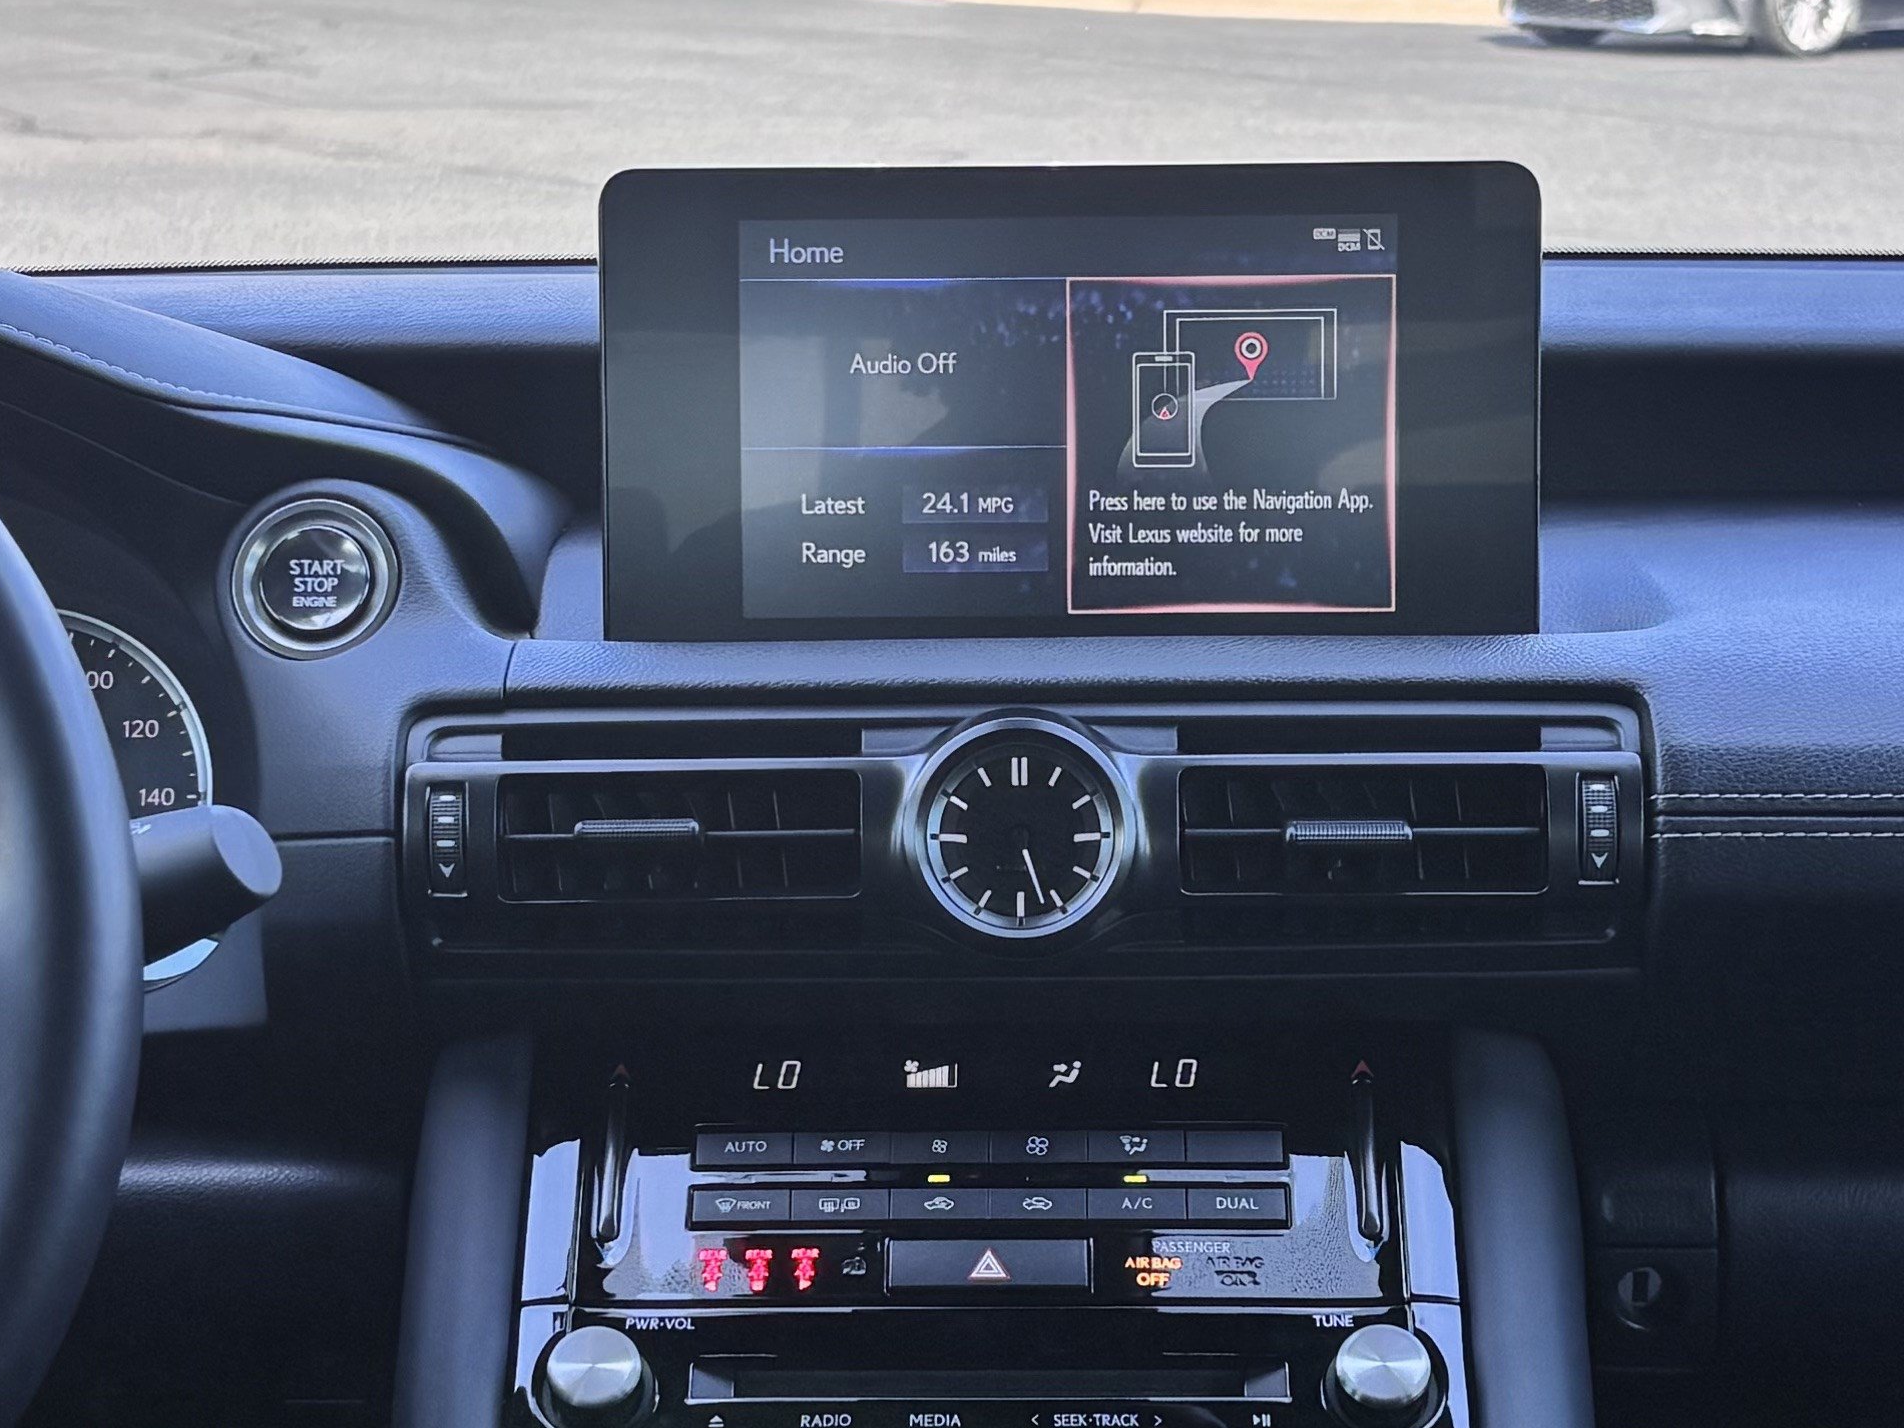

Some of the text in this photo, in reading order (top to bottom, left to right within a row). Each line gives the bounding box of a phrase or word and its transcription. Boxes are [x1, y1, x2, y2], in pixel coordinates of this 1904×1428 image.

[769, 237, 844, 264] Home
[849, 352, 957, 375] Audio Off
[801, 492, 1014, 516] Latest 24.1 MPG
[1089, 488, 1374, 514] Press here to use the Navigation App.
[1088, 521, 1304, 544] Visit Lexus website for more
[801, 541, 1018, 569] Range 163 miles
[289, 559, 345, 576] START
[1088, 555, 1177, 577] information.
[294, 577, 339, 593] STOP
[292, 595, 338, 608] ENGINE
[122, 719, 160, 739] 120
[138, 788, 176, 806] 140
[724, 1140, 768, 1154] AUTO
[837, 1138, 866, 1152] OFF
[736, 1200, 772, 1211] FRONT
[1121, 1196, 1153, 1211] A/C
[1215, 1196, 1260, 1211] DUAL
[1152, 1241, 1231, 1254] PASSENGER
[1135, 1272, 1172, 1288] OFF
[1312, 1314, 1355, 1328] TUNE
[800, 1414, 852, 1428] RADIO
[909, 1413, 962, 1427] MEDIA
